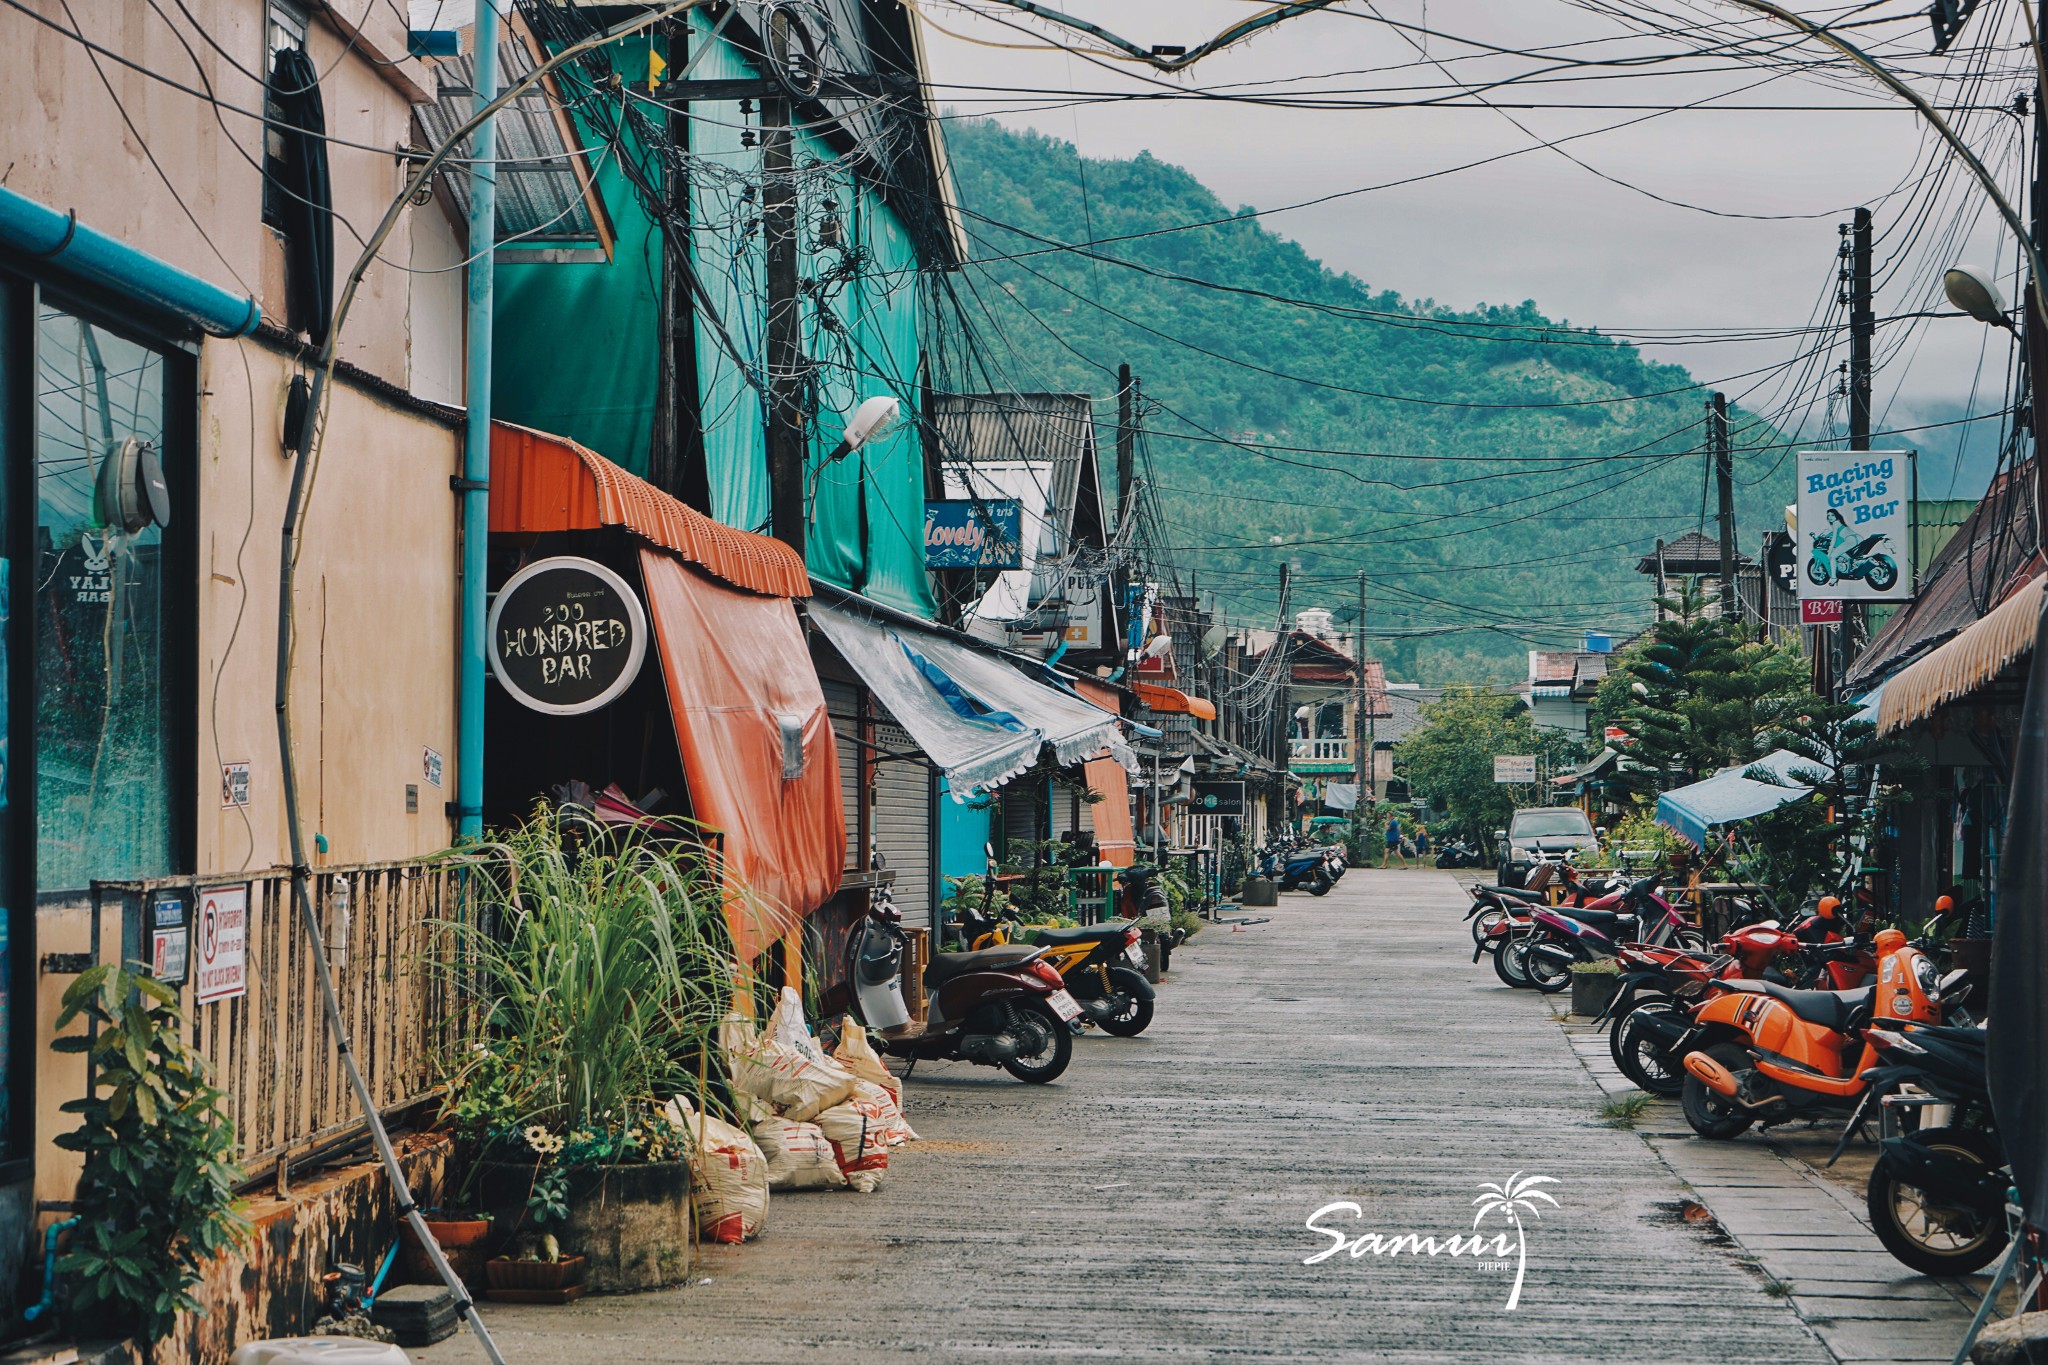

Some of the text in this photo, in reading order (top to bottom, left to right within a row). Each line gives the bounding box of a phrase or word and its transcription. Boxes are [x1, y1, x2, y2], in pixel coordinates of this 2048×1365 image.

[1807, 458, 1893, 494] Racing
[1828, 481, 1887, 508] Girls
[1853, 499, 1899, 525] Bar
[504, 618, 627, 658] HUNDRED
[542, 653, 593, 686] BAR
[1192, 797, 1242, 806] OME salon
[1897, 972, 1905, 984] 1
